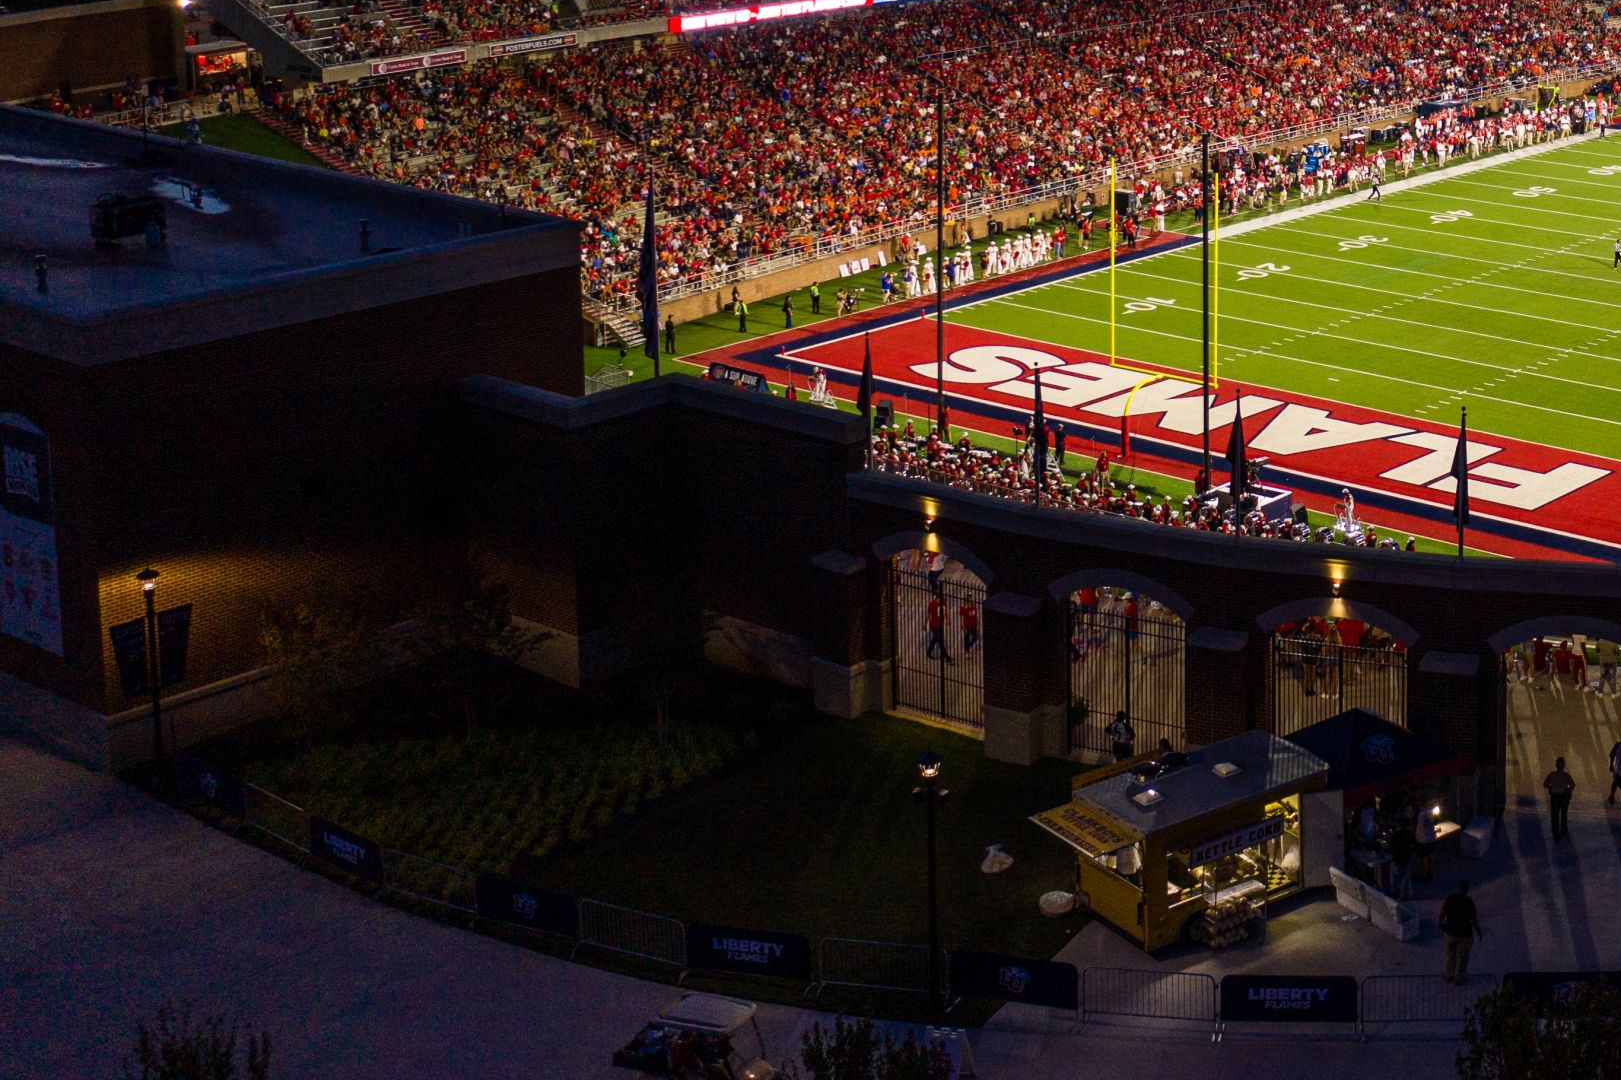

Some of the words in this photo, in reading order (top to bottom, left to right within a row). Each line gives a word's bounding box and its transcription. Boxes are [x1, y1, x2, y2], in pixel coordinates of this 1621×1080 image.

[505, 38, 563, 52] FOSTERFUELS.COM
[1512, 186, 1557, 198] 50
[1430, 209, 1473, 222] 40
[1338, 235, 1389, 249] 30
[1237, 262, 1292, 278] 20
[1124, 297, 1176, 311] 10
[911, 345, 1612, 511] FLAMES
[323, 831, 367, 861] LIBERTY
[1195, 835, 1243, 861] KETTLE
[1248, 820, 1281, 843] CORN
[711, 936, 785, 958] LIBERTY
[727, 950, 769, 964] FLAMES
[1248, 986, 1329, 1002] LIBERTY
[1264, 1000, 1312, 1010] FLAMES
